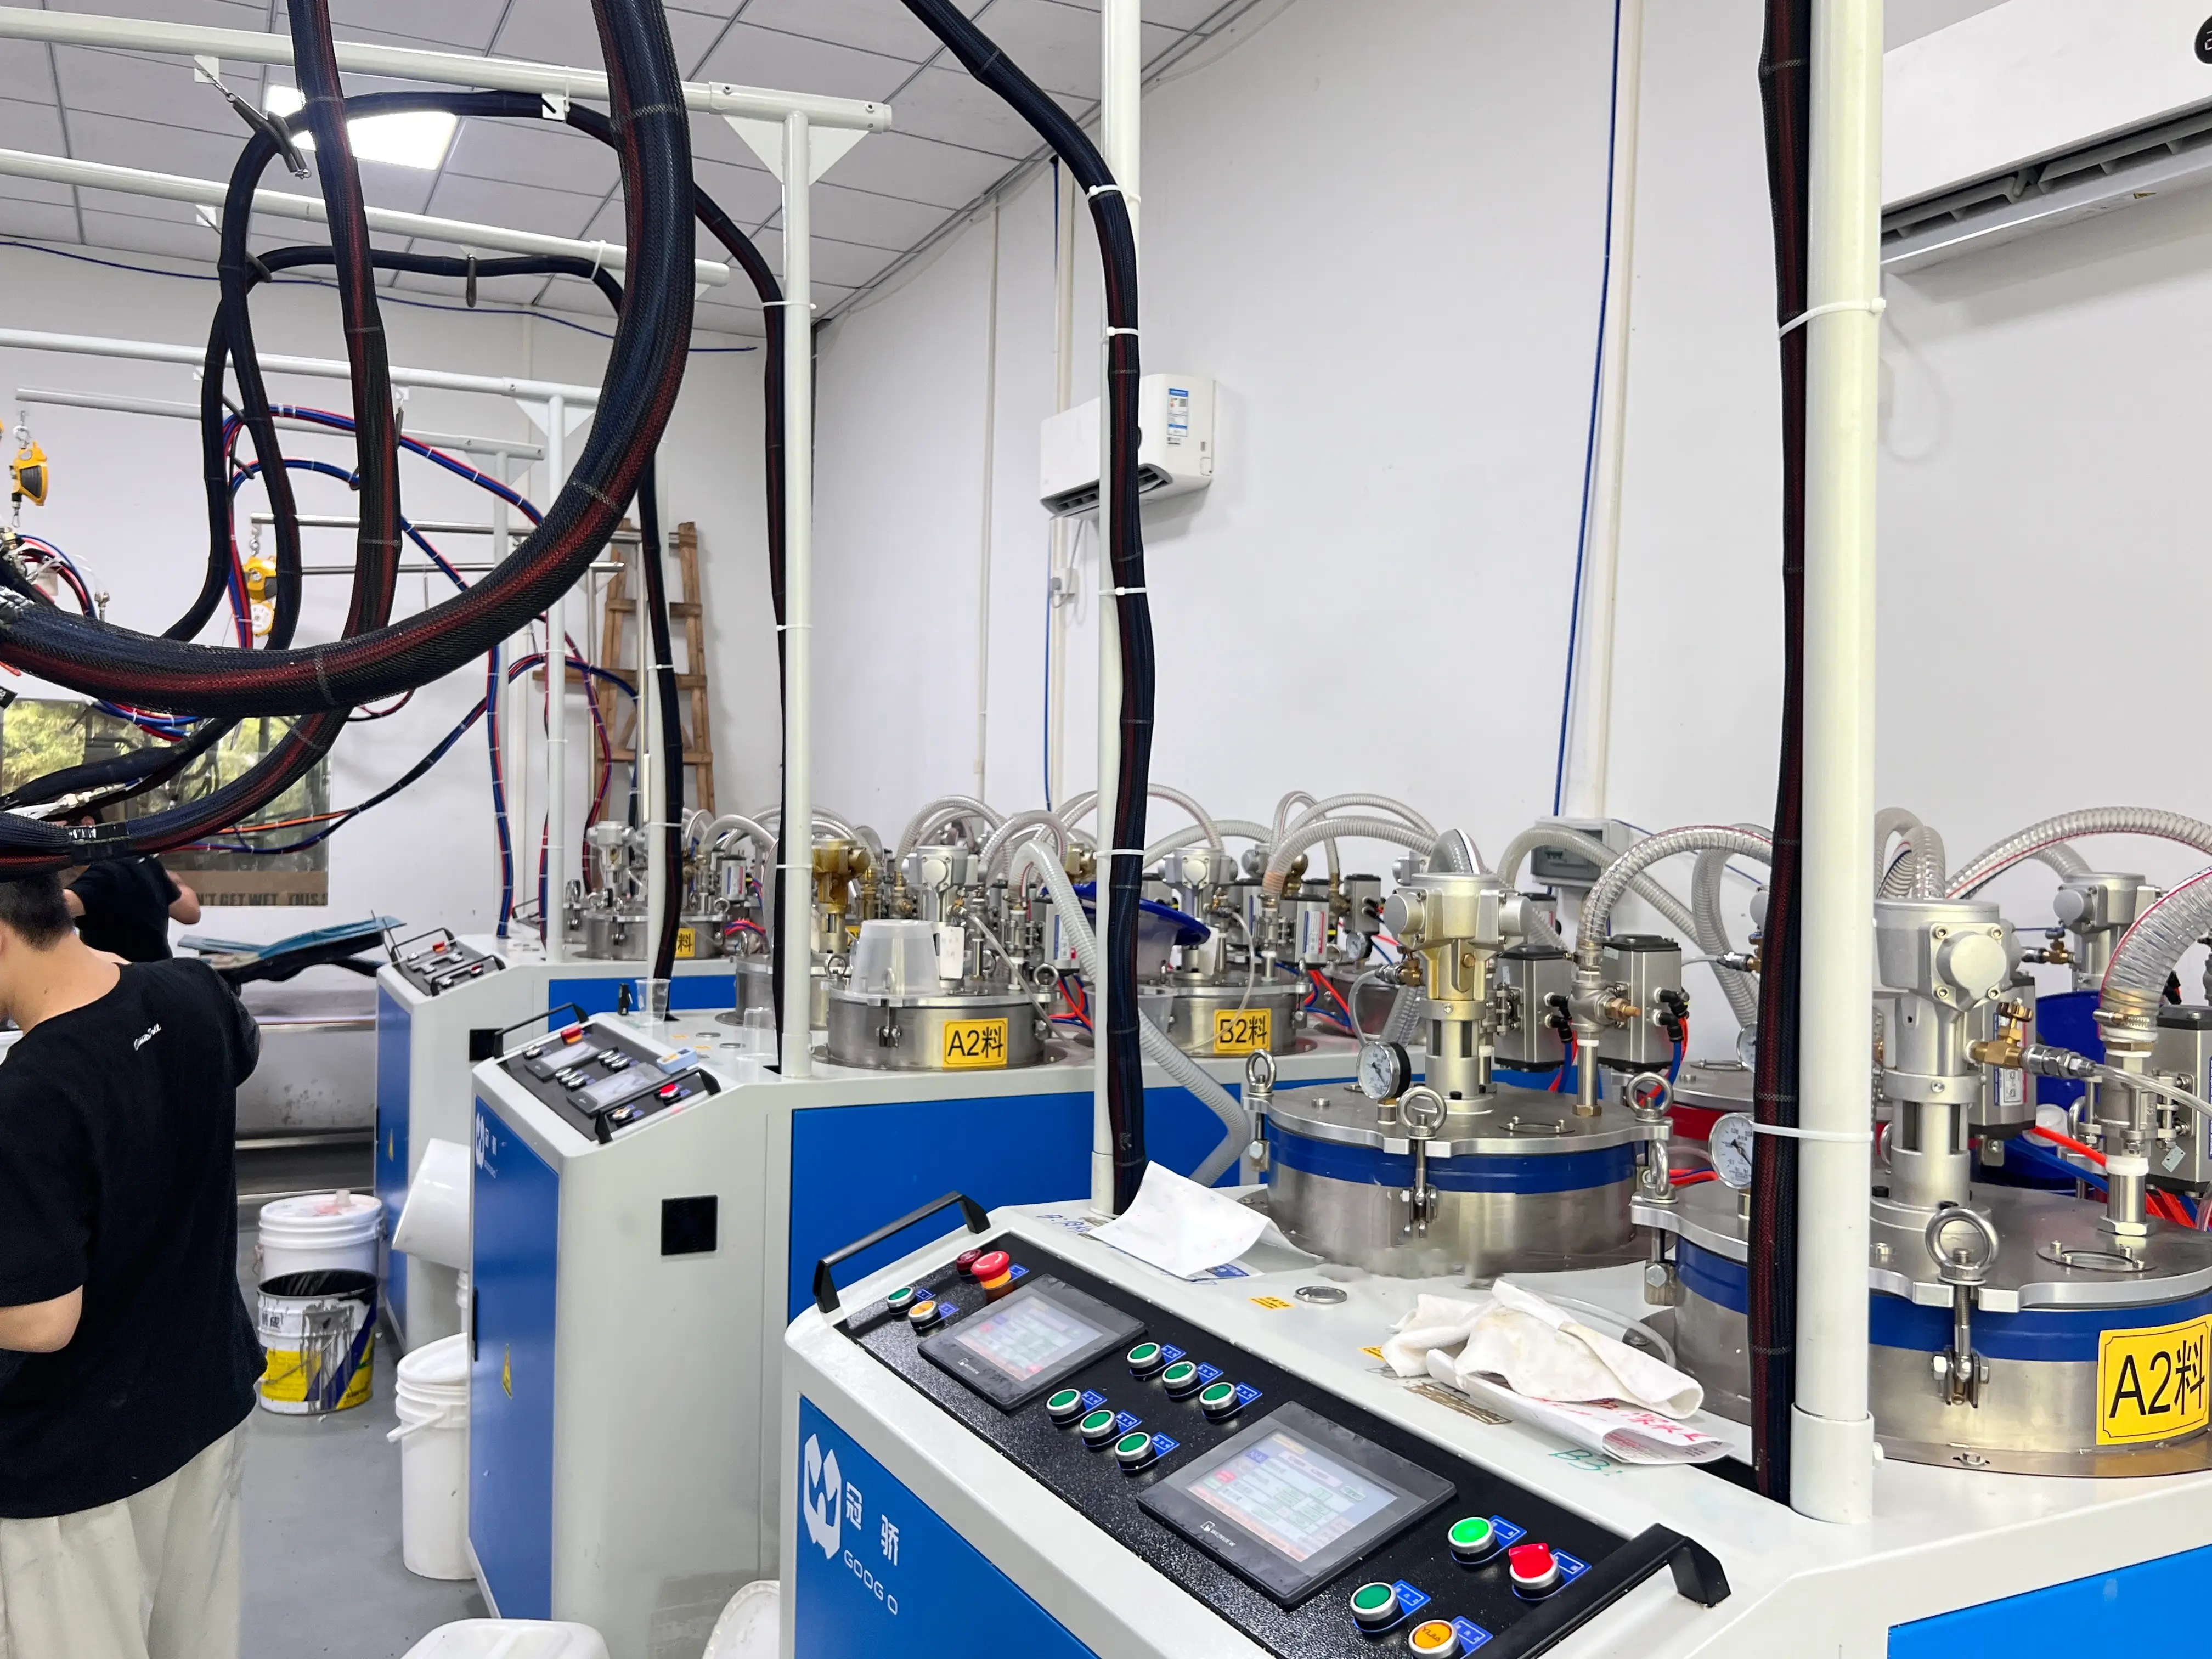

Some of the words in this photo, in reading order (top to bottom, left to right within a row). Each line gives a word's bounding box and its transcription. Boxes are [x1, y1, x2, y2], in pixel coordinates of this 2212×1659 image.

[219, 892, 246, 906] GET
[947, 1026, 1004, 1058] A2料
[1219, 1015, 1268, 1045] B2料
[2109, 1334, 2206, 1419] A2料
